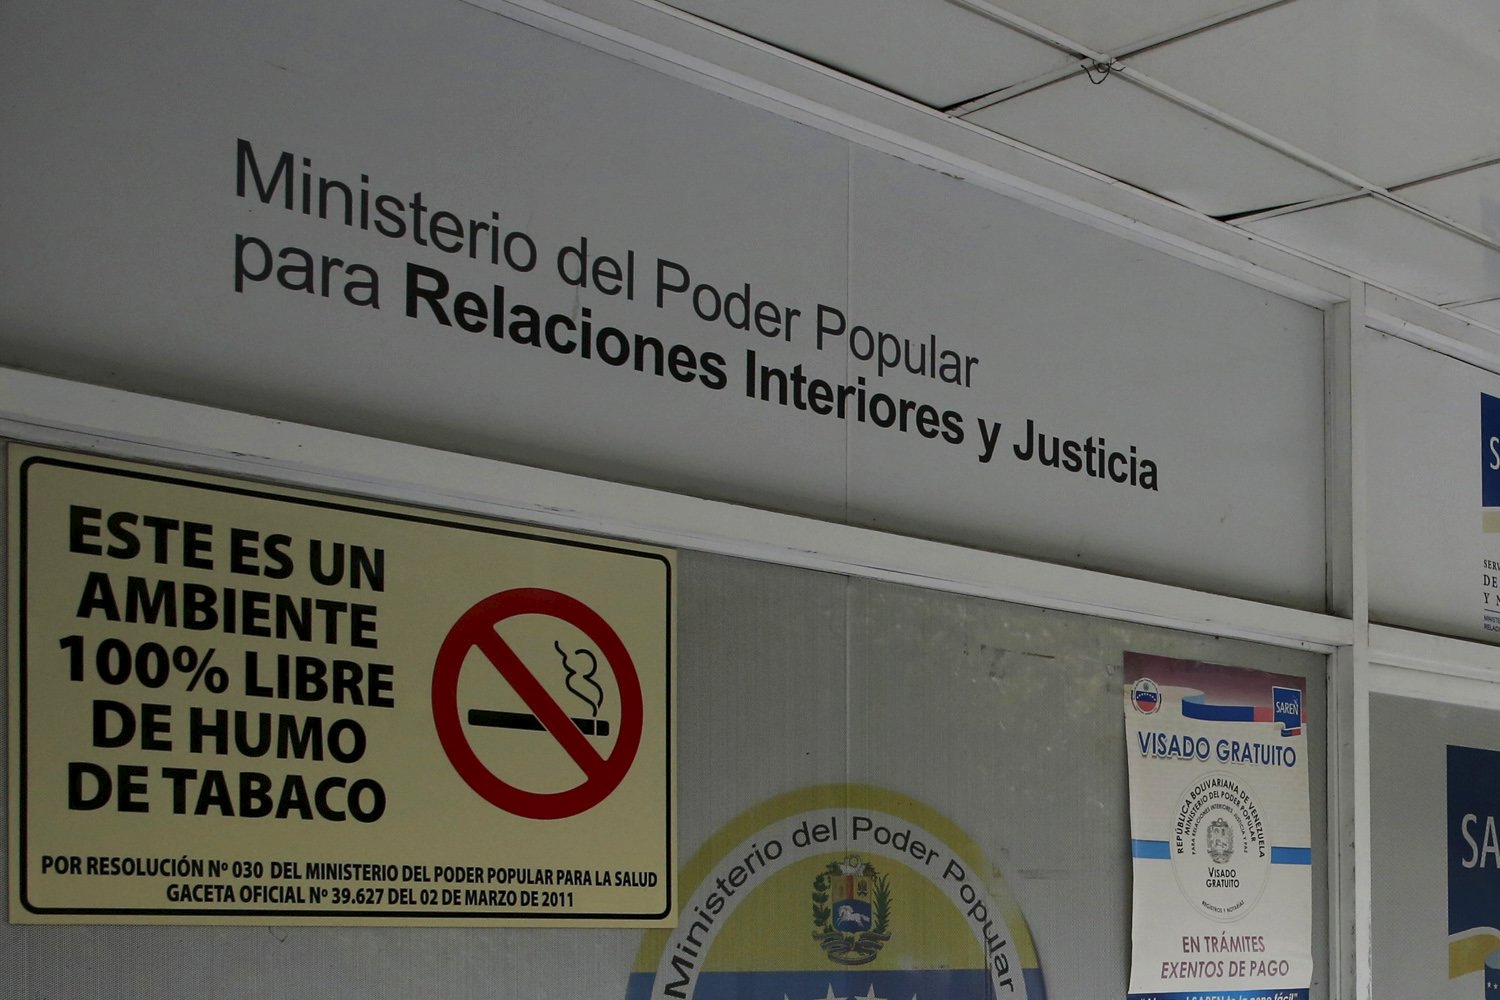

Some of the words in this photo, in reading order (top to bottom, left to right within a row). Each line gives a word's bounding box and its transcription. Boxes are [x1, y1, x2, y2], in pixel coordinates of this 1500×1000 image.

[236, 139, 538, 272] Ministerio
[557, 237, 635, 301] del
[656, 258, 801, 343] Poder
[815, 304, 980, 388] Popular
[234, 232, 381, 309] para
[404, 262, 727, 390] Relaciones
[745, 349, 965, 445] Interiores
[978, 413, 1001, 464] y
[1013, 418, 1159, 492] Justicia
[69, 505, 213, 569] ESTE
[230, 529, 293, 580] ES
[309, 540, 386, 592] UN
[1483, 574, 1498, 588] DE
[1483, 592, 1490, 604] Y
[76, 571, 378, 649] AMBIENTE
[59, 635, 229, 695] 100%
[244, 652, 395, 708] LIBRE
[92, 700, 172, 751] DE
[189, 707, 366, 764] HUMO
[1276, 701, 1299, 716] SAREN
[1138, 731, 1210, 759] VISADO
[1216, 739, 1296, 768] GRATUITO
[67, 762, 149, 813] DE
[162, 768, 386, 823] TABACO
[1175, 799, 1192, 854] REPÚBLICA
[1190, 778, 1239, 800] BOLIVARIANA
[1240, 791, 1250, 804] DE
[1248, 802, 1265, 858] VENEZUELA
[1185, 795, 1208, 835] MINISTERIO
[1209, 791, 1220, 799] DEL
[1221, 791, 1241, 808] PODER
[1240, 806, 1256, 842] POPULAR
[42, 856, 82, 875] POR
[86, 855, 204, 878] RESOLUCIÓN
[232, 861, 263, 879] 030
[271, 862, 301, 880] DEL
[305, 863, 398, 882] MINISTERIO
[403, 865, 430, 883] DEL
[433, 865, 483, 885] PODER
[487, 867, 553, 886] POPULAR
[556, 868, 592, 887] PARA
[596, 869, 612, 887] LA
[614, 870, 657, 888] SALUD
[166, 883, 235, 903] GACETA
[240, 885, 305, 904] OFICIAL
[331, 887, 384, 905] 39.627
[388, 888, 417, 906] DEL
[420, 888, 439, 906] 02
[442, 889, 463, 906] DE
[465, 889, 516, 907] MARZO
[519, 890, 539, 907] DE
[541, 891, 574, 908] 2011
[1206, 879, 1239, 888] GRATUITO
[663, 839, 783, 1000] Ministerio
[791, 817, 838, 849] del
[852, 816, 938, 867] Poder
[943, 859, 1014, 992] Popular
[1182, 936, 1200, 953] EN
[1204, 931, 1265, 953] TRÁMITES
[1161, 960, 1224, 979] EXENTOS
[1229, 960, 1246, 977] DE
[1250, 960, 1289, 977] PAGO
